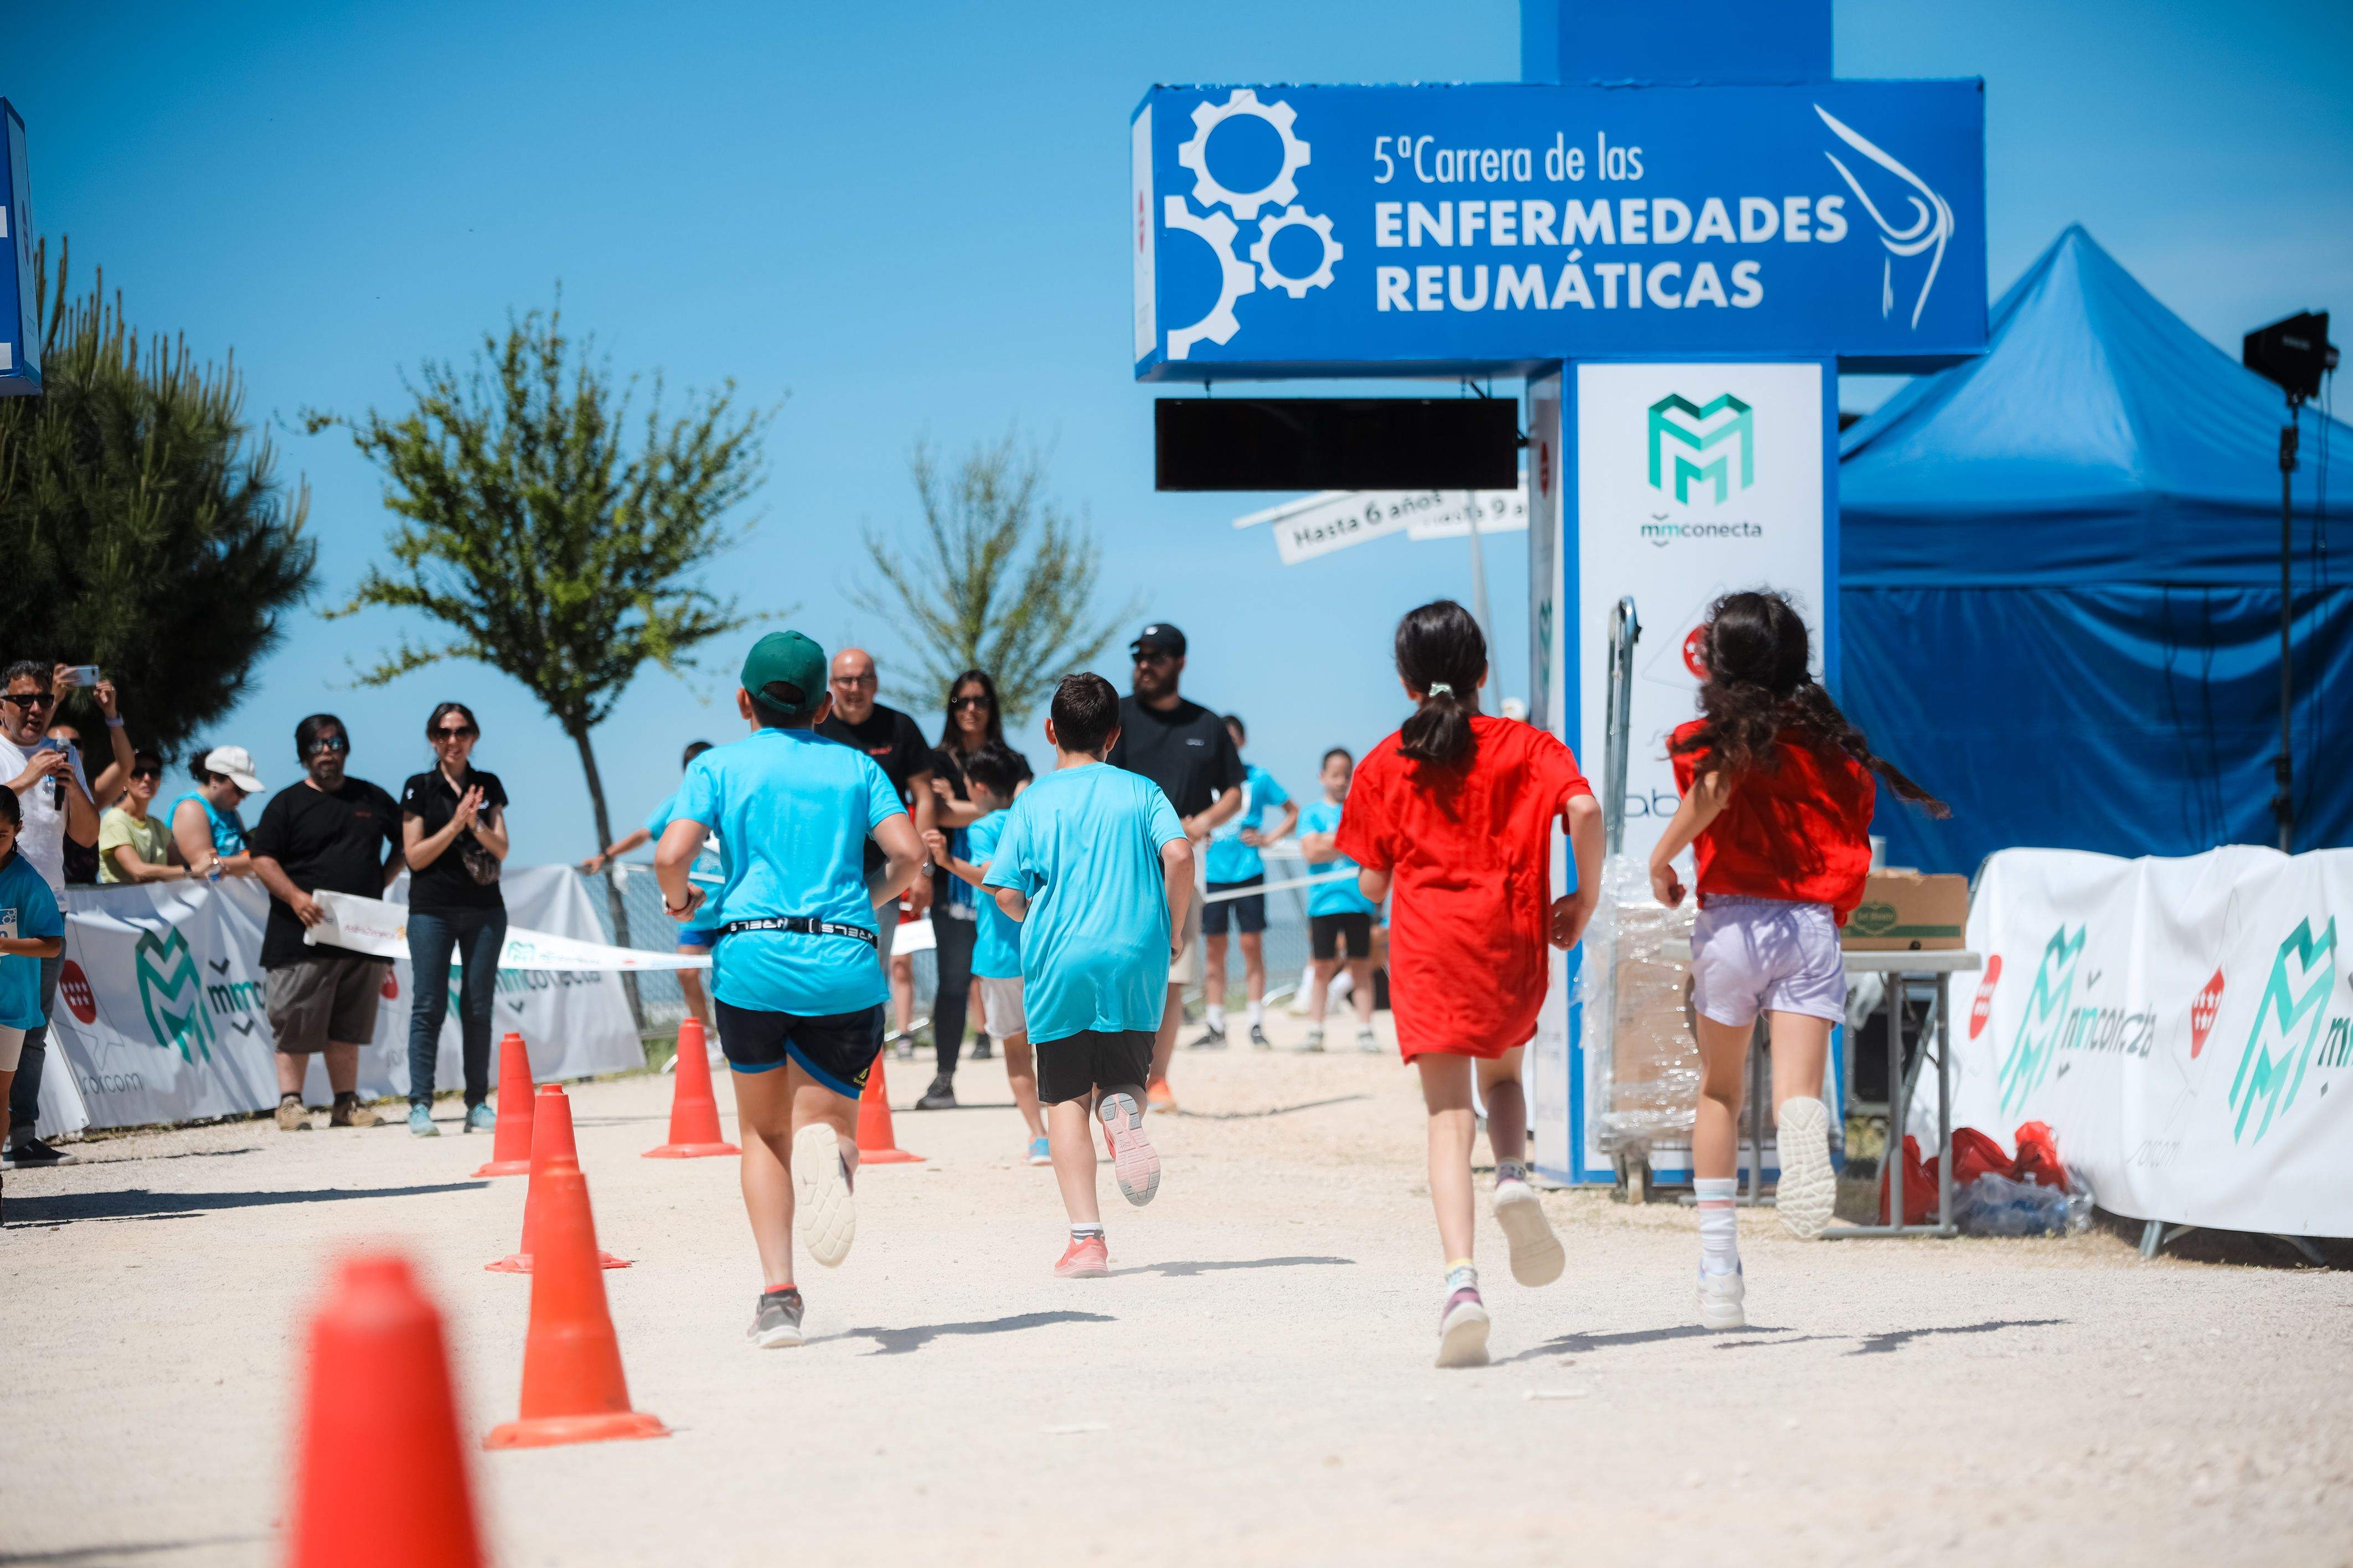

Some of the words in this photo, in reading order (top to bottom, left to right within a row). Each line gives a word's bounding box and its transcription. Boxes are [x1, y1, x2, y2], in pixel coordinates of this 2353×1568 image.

[1545, 132, 1585, 181] de
[1598, 132, 1643, 180] las
[1376, 196, 1848, 247] ENFERMEDADES
[1376, 249, 1763, 312] REUMÁTICAS
[1292, 516, 1359, 550] Hasta
[1363, 501, 1382, 526] 6
[1391, 490, 1443, 519] años
[1492, 497, 1506, 515] 9
[1640, 520, 1763, 539] mmconecta
